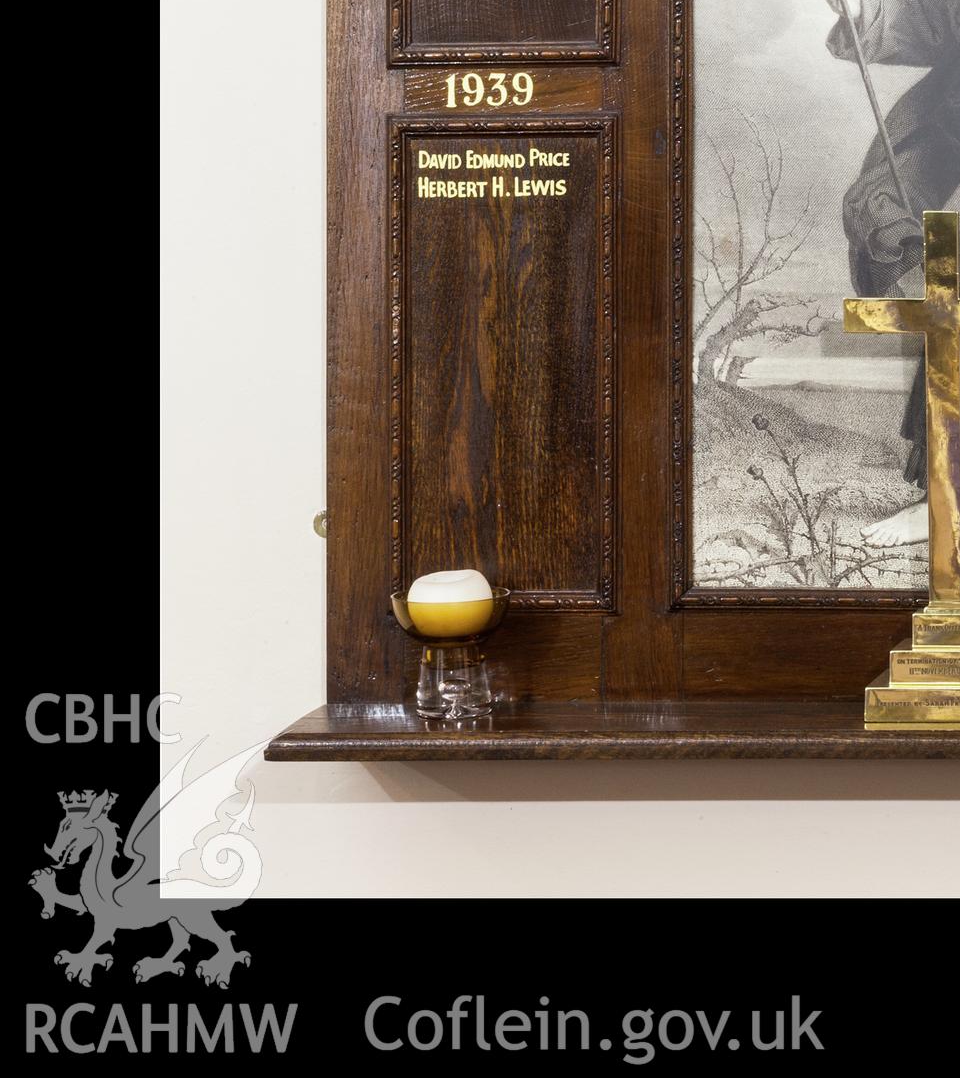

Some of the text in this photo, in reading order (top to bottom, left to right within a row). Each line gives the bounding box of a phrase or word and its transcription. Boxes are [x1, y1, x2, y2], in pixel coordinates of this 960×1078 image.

[445, 72, 534, 108] 1939
[418, 148, 570, 169] DAVID EDMUND PRICE
[418, 176, 567, 198] HERBERT H. LEWIS
